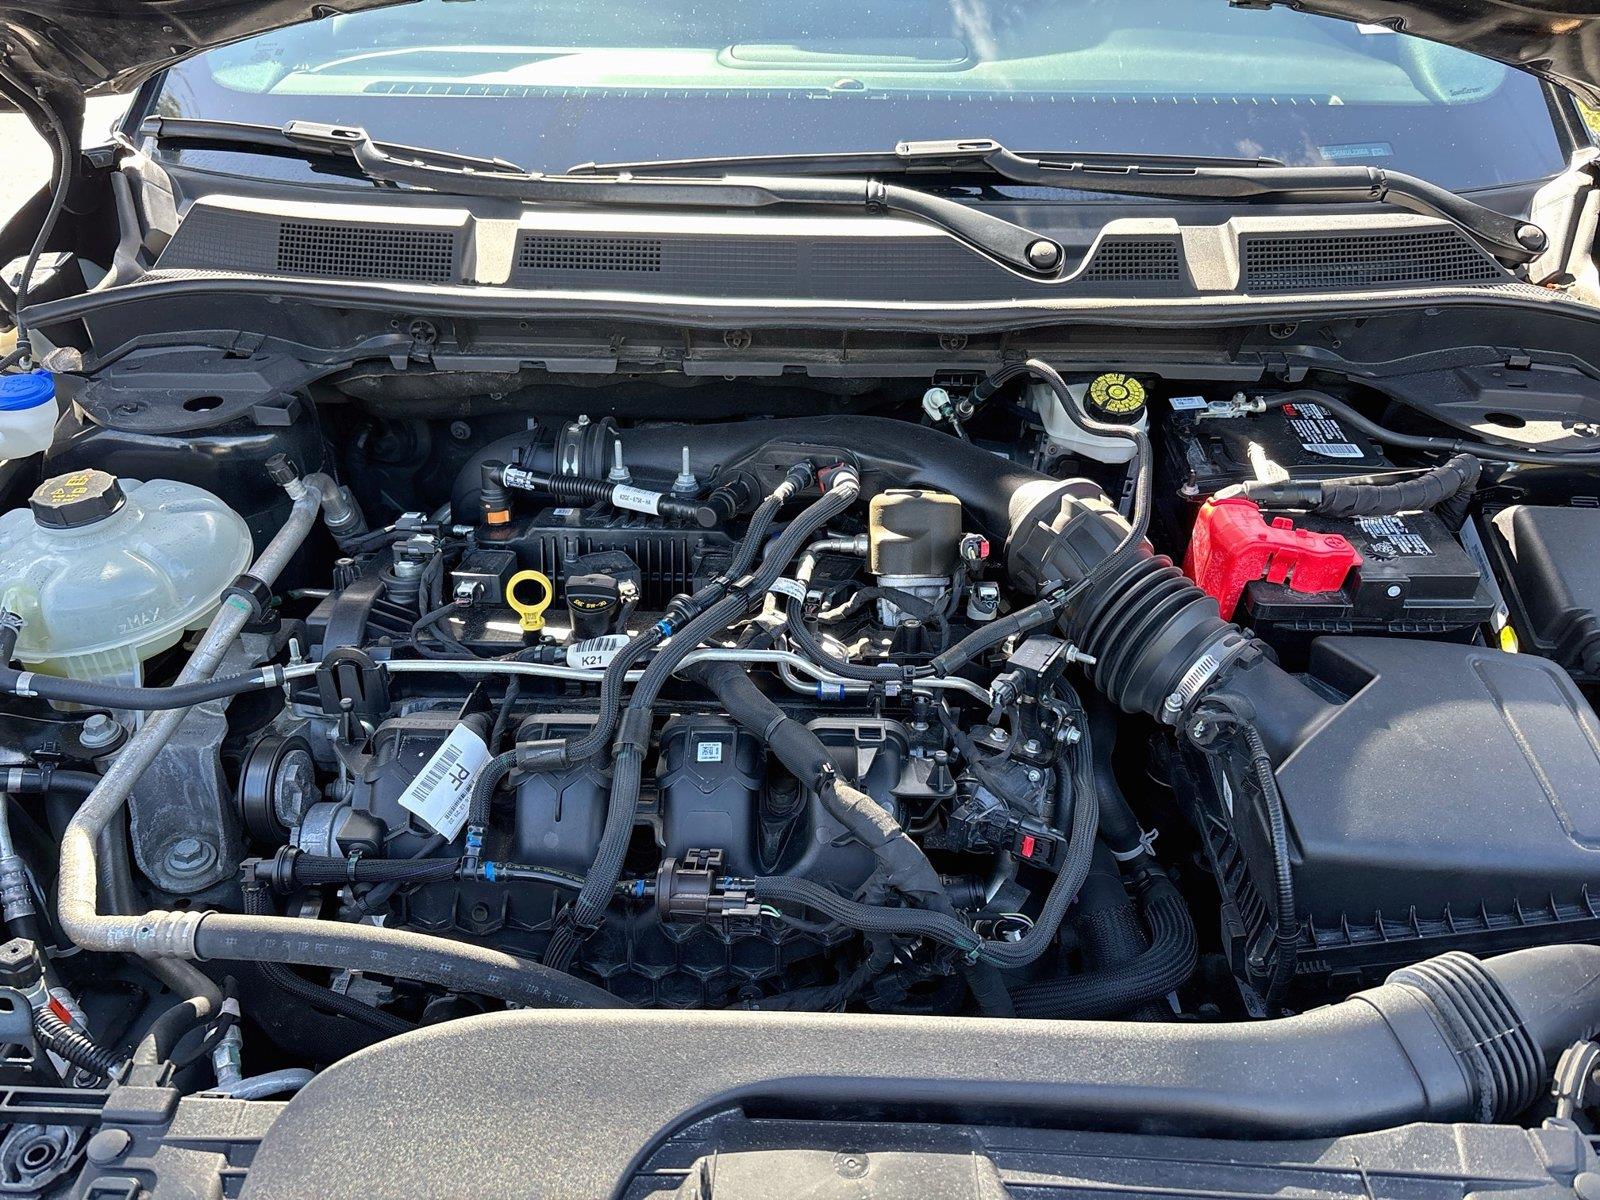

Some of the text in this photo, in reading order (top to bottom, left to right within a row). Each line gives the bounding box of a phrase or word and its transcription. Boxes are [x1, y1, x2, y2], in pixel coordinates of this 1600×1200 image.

[126, 607, 160, 629] MAX
[581, 655, 602, 666] K21
[448, 763, 470, 791] PF
